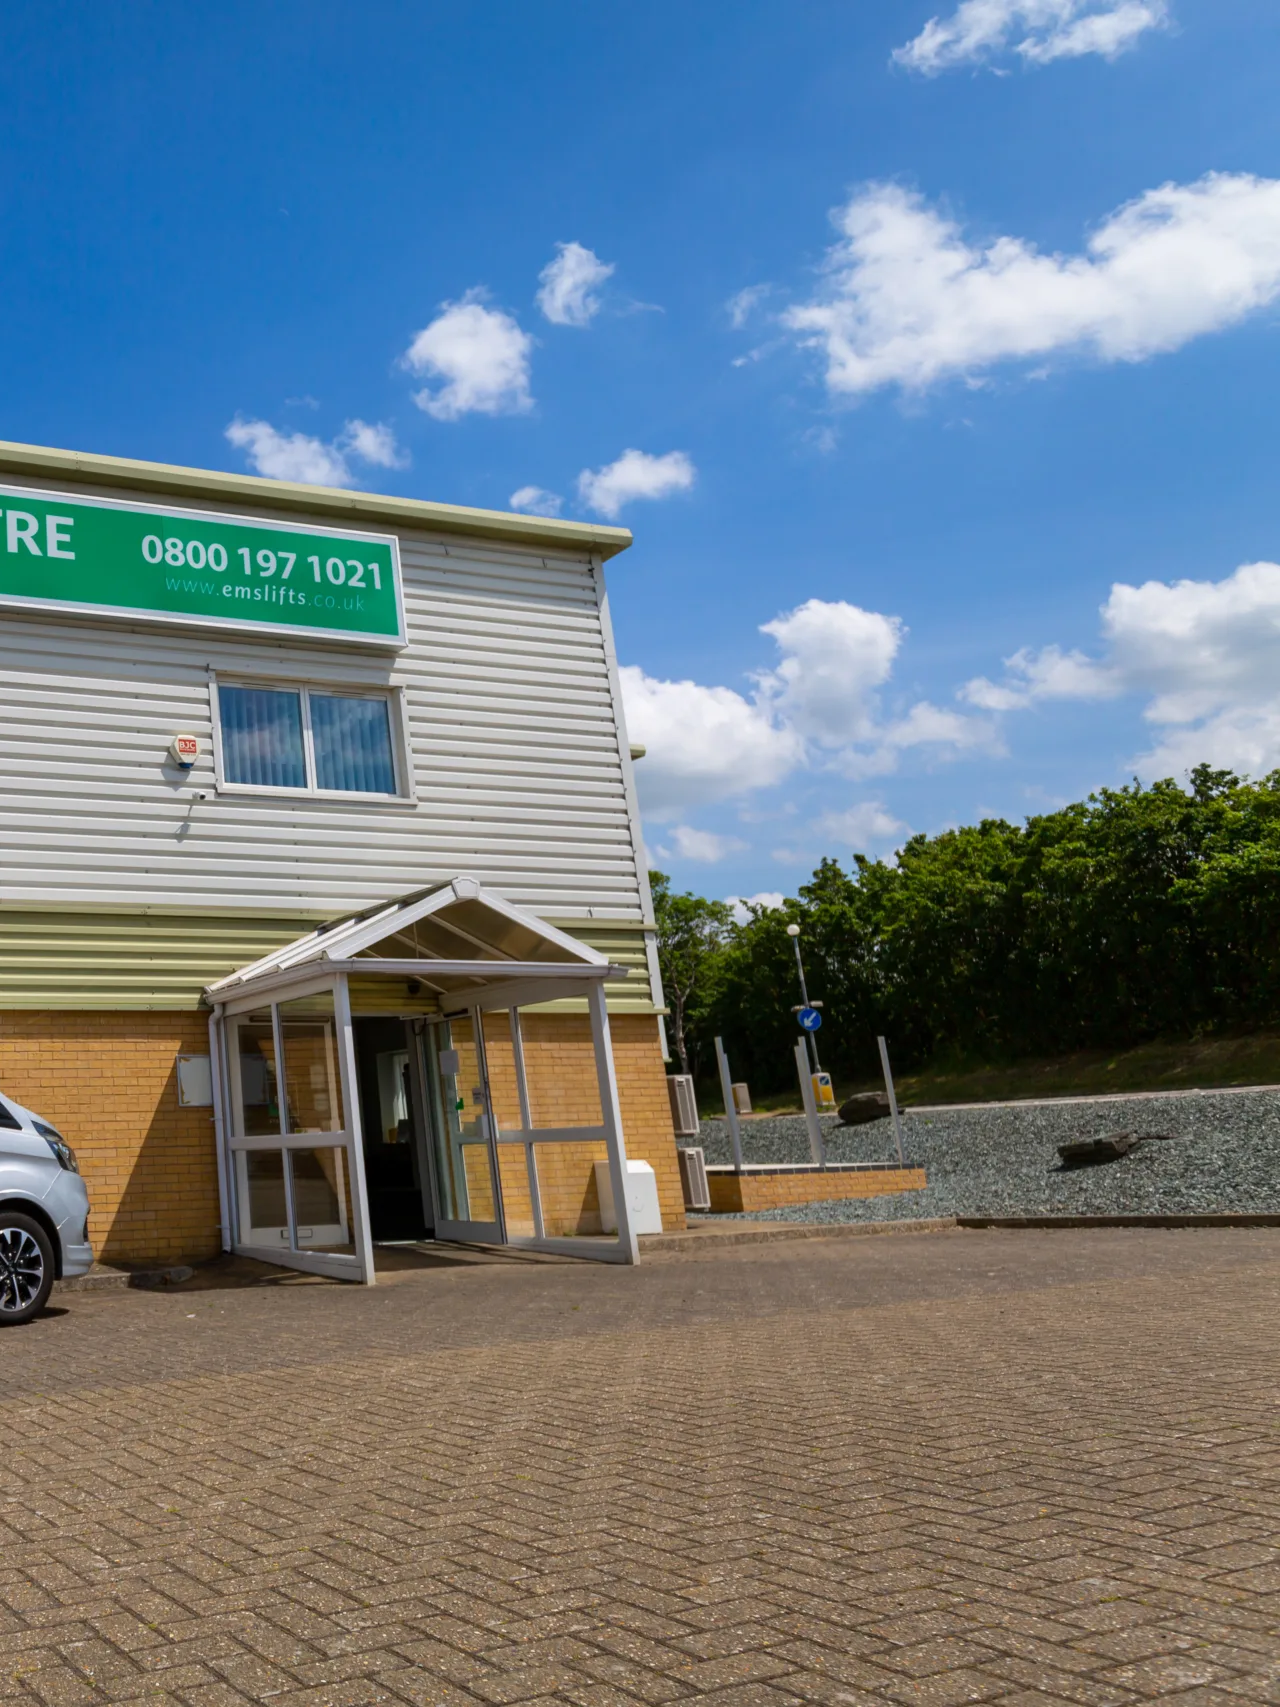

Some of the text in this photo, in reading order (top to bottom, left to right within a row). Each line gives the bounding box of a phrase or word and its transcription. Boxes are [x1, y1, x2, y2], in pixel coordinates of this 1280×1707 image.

[141, 534, 382, 590] 0800 197 1021
[165, 577, 365, 612] www.emslifts.co.uk
